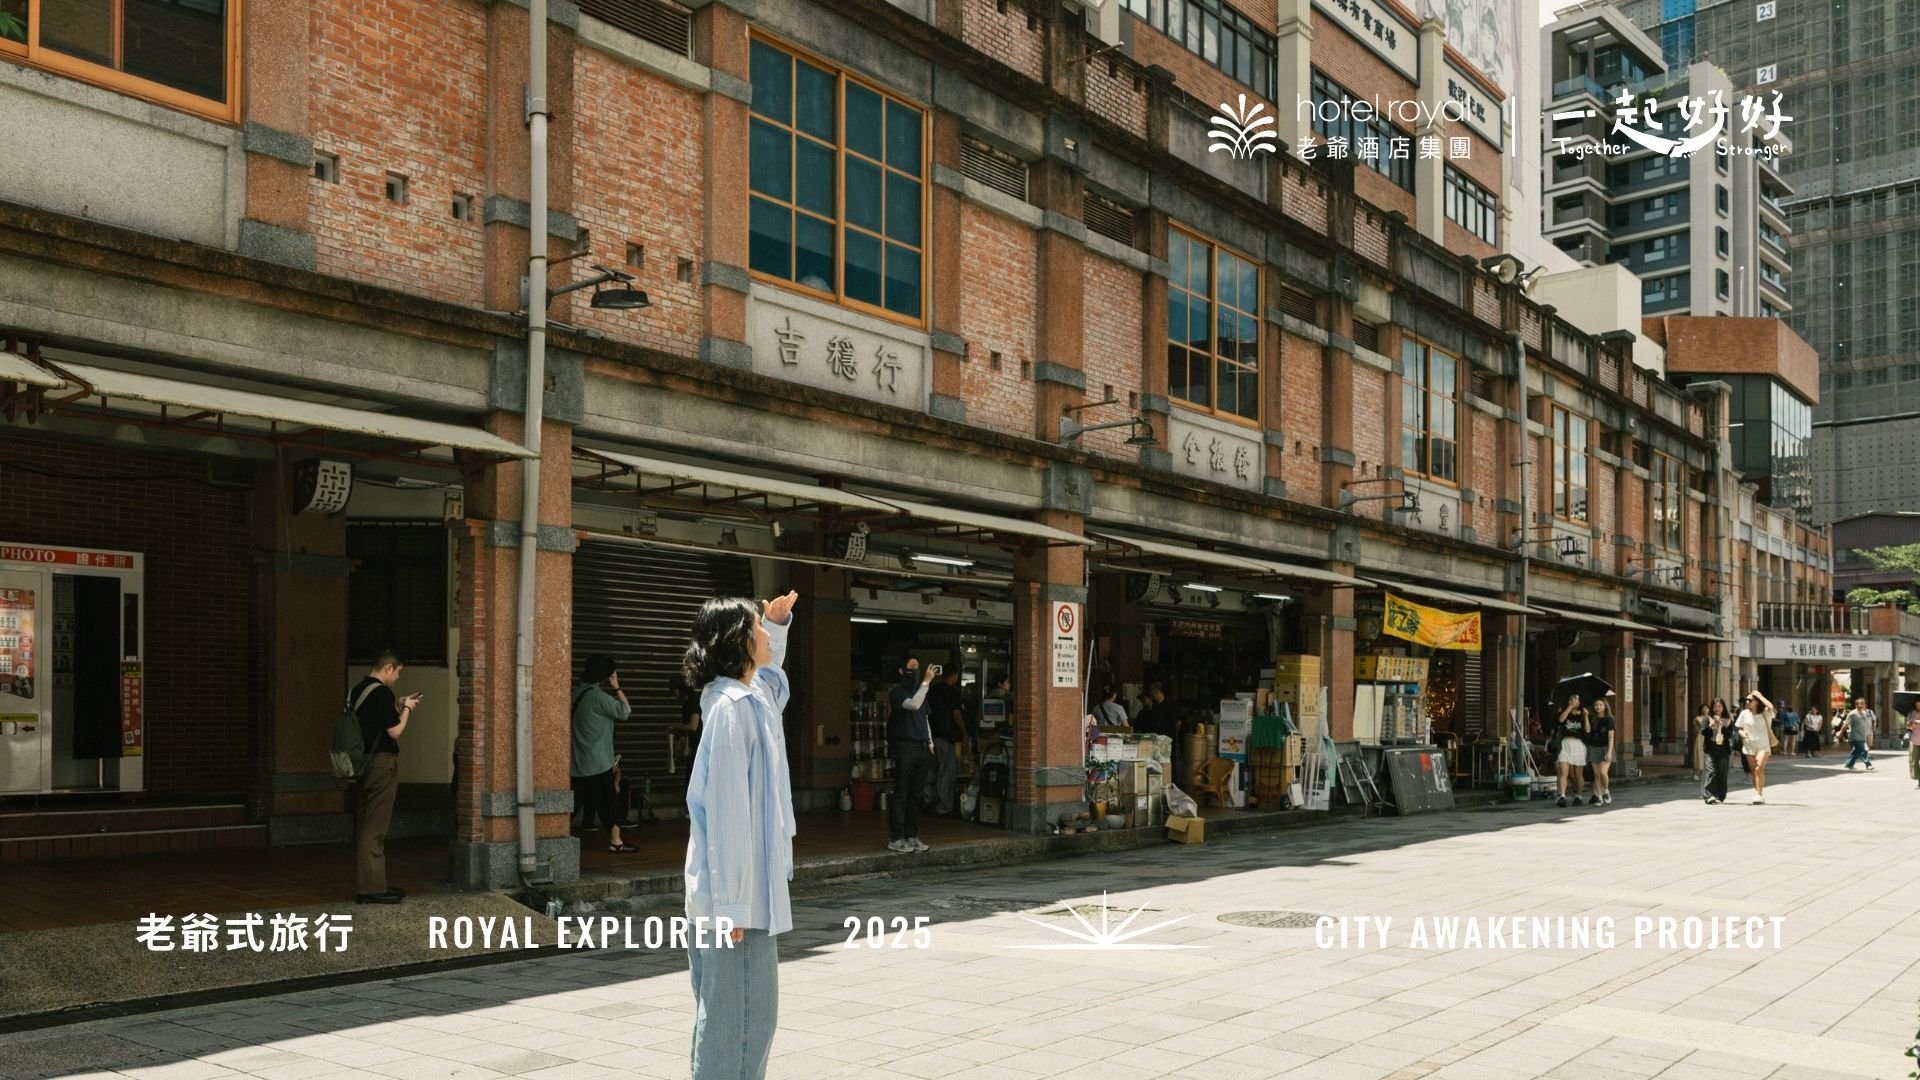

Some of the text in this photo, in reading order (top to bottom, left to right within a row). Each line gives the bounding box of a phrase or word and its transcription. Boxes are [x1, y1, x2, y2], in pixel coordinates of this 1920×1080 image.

[1760, 4, 1773, 18] 23
[1760, 67, 1774, 82] 21
[0, 547, 126, 567] PHOTO 證件照
